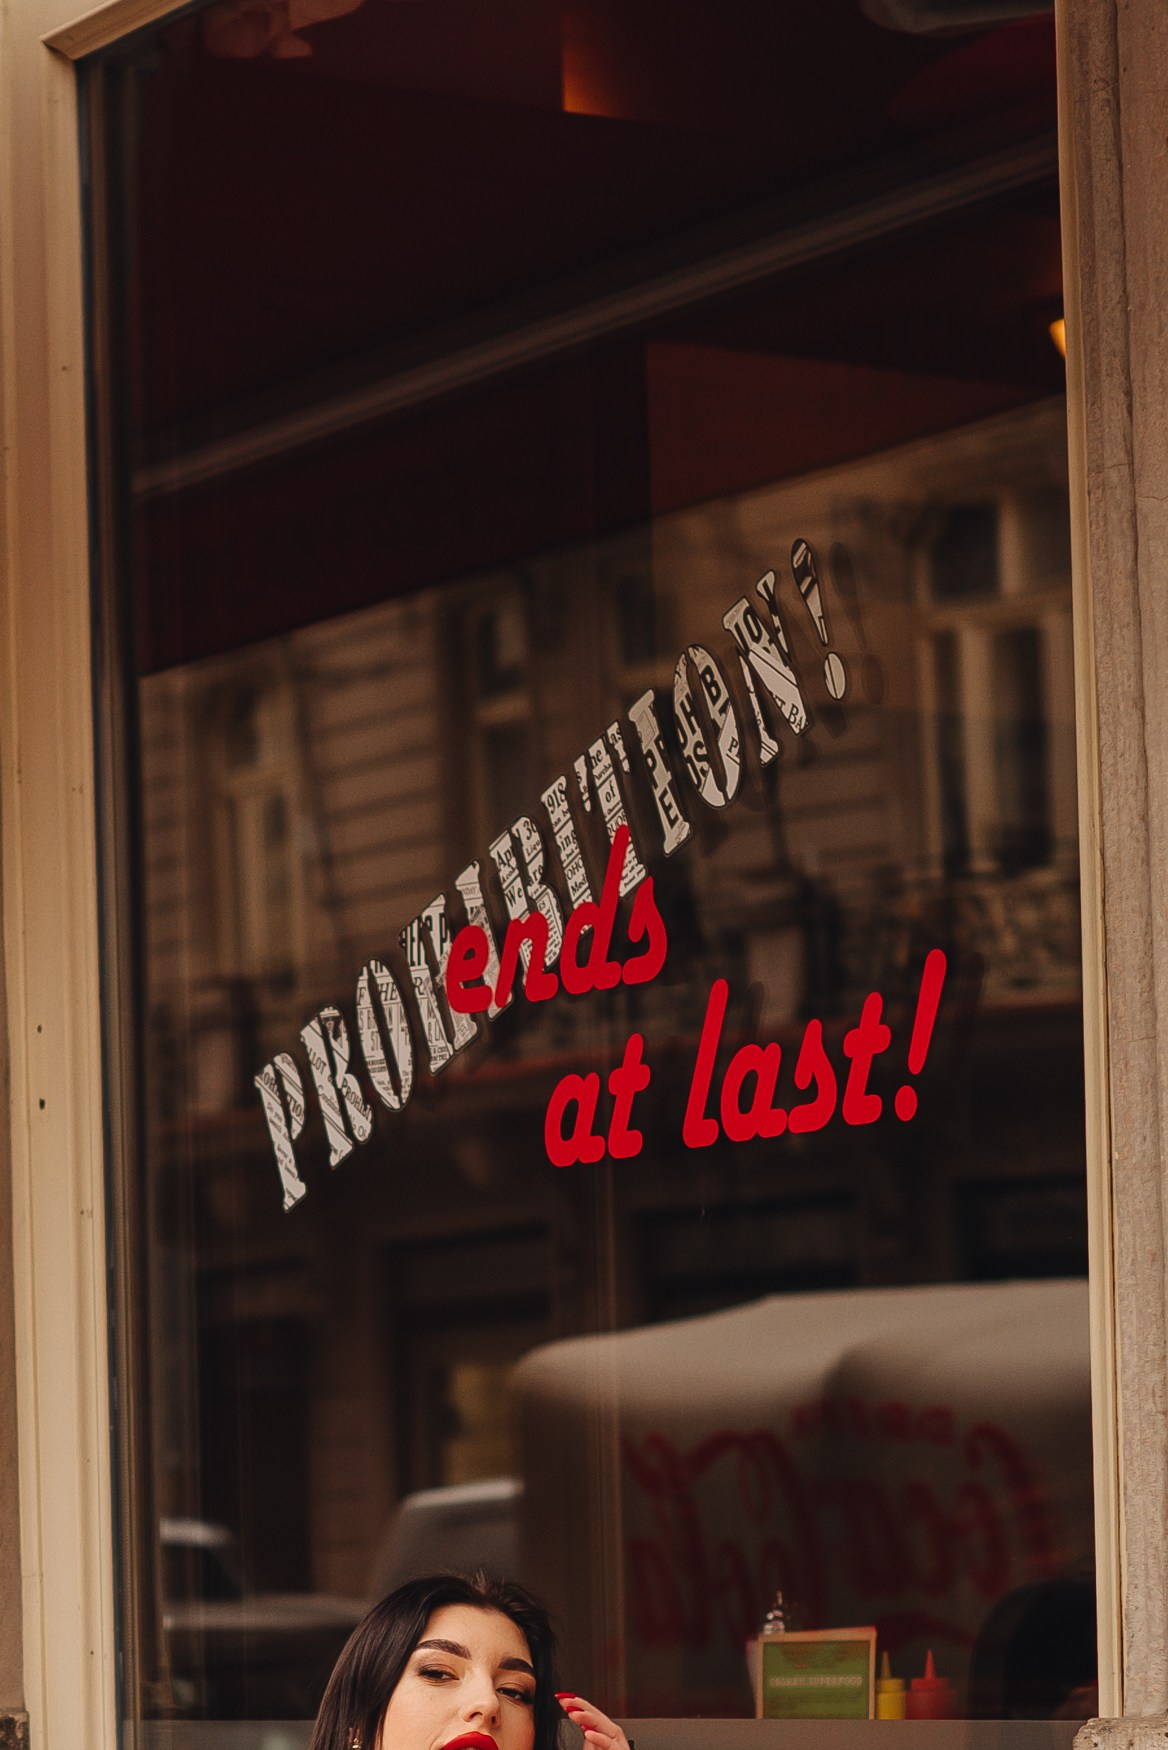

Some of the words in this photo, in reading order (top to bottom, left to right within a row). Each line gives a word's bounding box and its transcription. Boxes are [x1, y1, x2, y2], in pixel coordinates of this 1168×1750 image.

[444, 824, 668, 1014] ends
[544, 1032, 651, 1168] at
[682, 947, 947, 1149] last!
